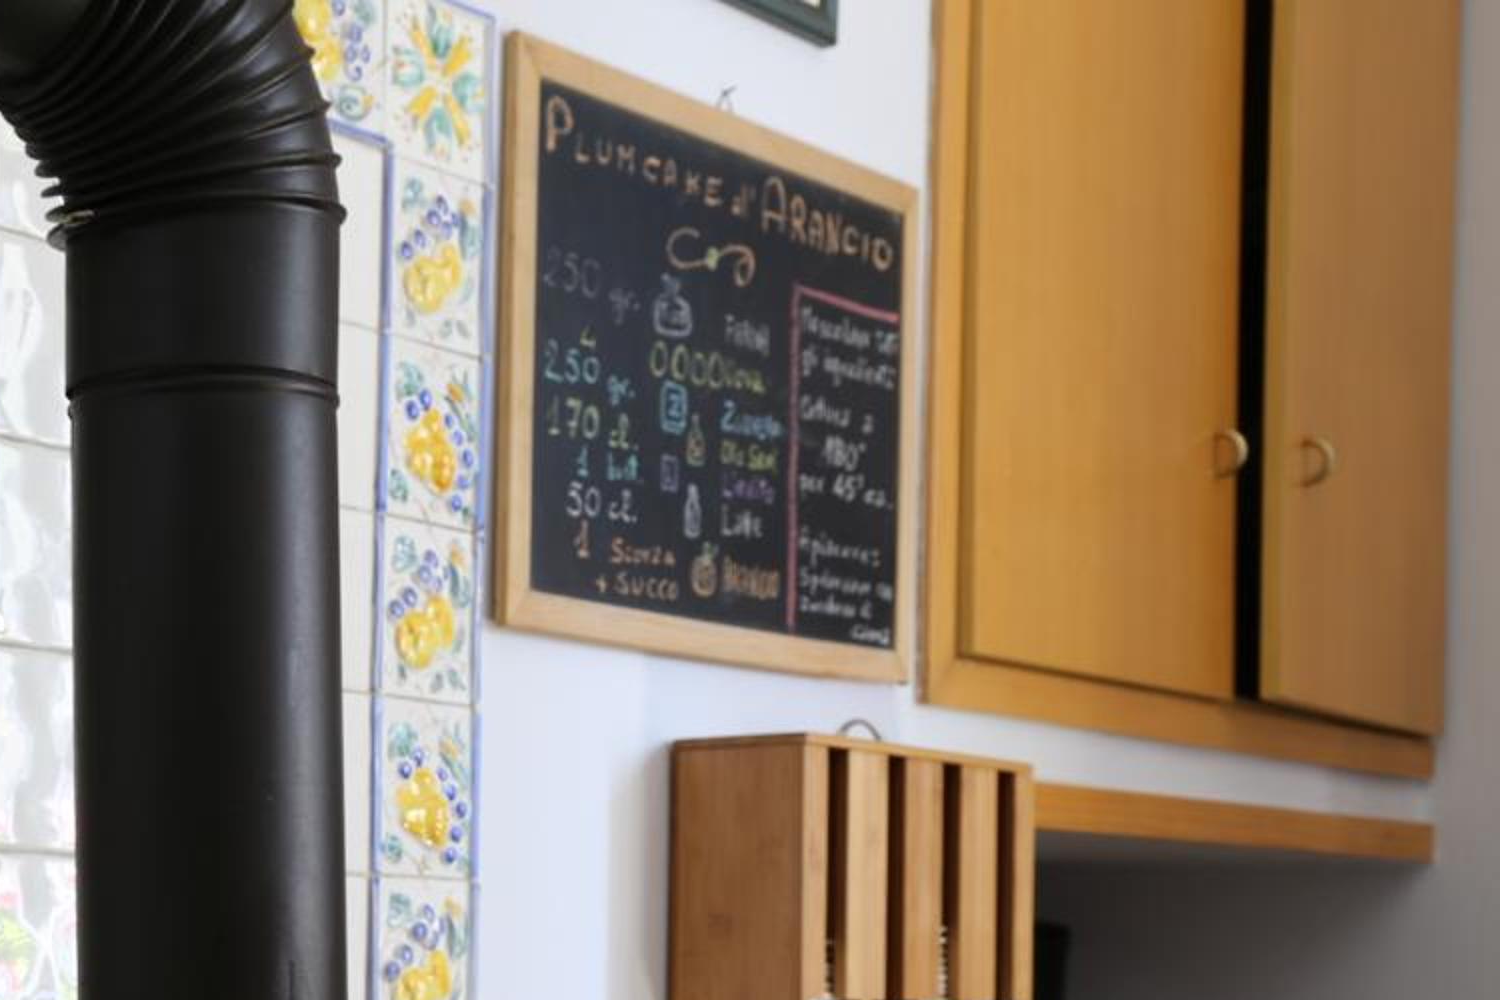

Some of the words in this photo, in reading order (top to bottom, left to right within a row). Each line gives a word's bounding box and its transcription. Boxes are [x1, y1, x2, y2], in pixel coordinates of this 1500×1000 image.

[760, 175, 894, 271] ARANCIO
[543, 246, 600, 298] 250
[544, 337, 600, 383] 250
[548, 395, 600, 440] 170
[565, 481, 601, 519] 50
